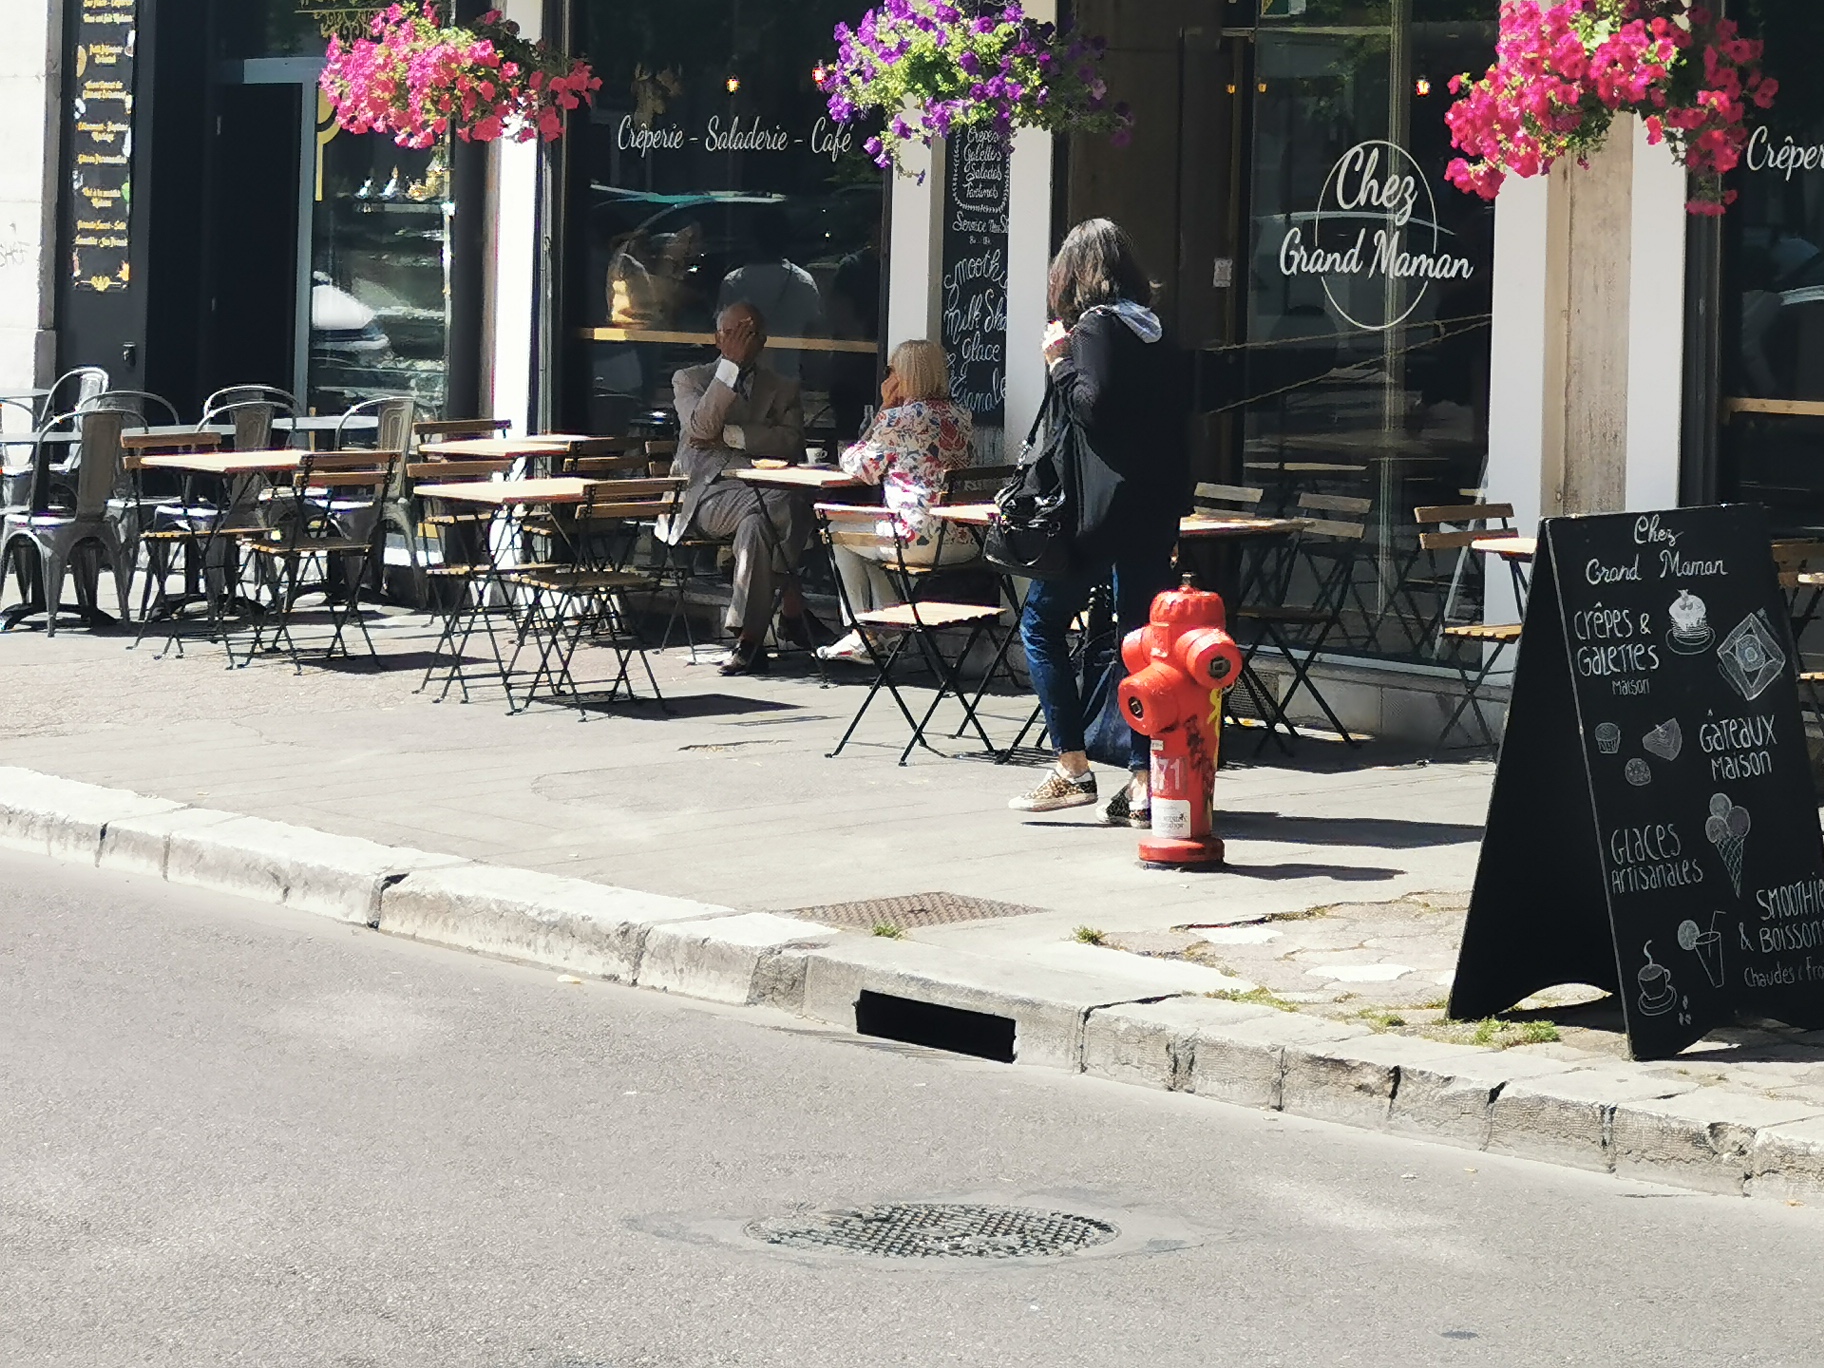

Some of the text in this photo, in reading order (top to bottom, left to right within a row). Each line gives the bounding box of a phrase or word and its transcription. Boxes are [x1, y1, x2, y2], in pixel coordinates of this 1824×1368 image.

[618, 115, 685, 159] Crêperie
[704, 116, 788, 153] Saladerie
[811, 118, 854, 163] Café
[1336, 148, 1419, 225] Chez
[1279, 228, 1474, 281] Grand Maman
[1633, 513, 1685, 547] Chez
[1585, 549, 1729, 586] Grand Maman
[1639, 612, 1652, 635] &
[1738, 921, 1755, 952] &
